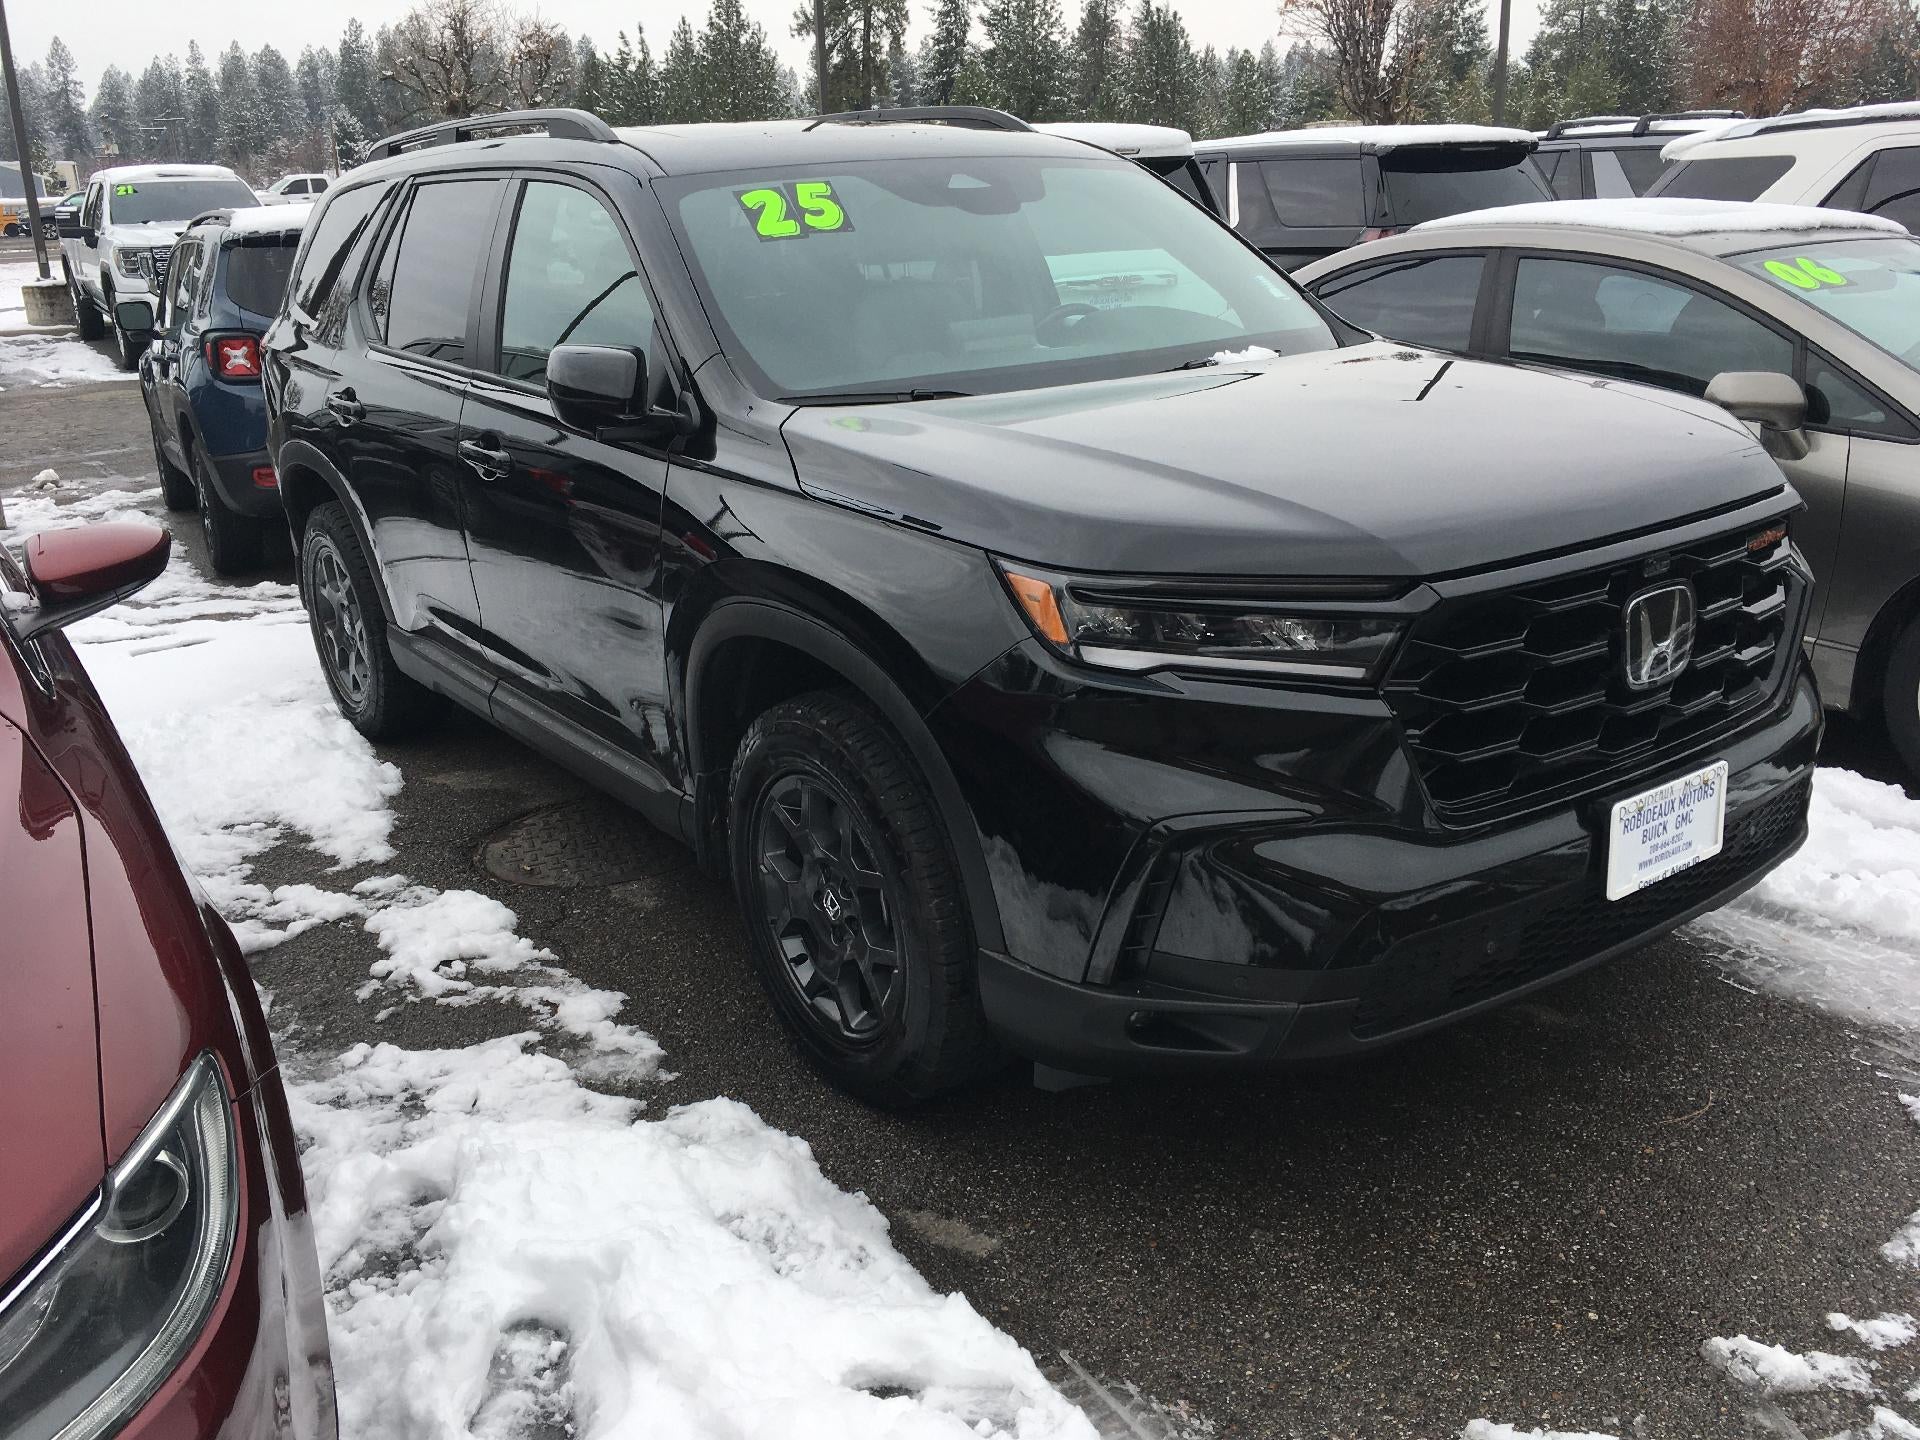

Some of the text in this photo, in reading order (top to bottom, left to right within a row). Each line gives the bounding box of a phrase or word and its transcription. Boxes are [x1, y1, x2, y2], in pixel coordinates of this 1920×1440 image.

[116, 185, 135, 196] 21
[740, 182, 844, 237] 25
[1763, 257, 1848, 289] 06
[1682, 766, 1726, 795] MOORS
[1623, 781, 1715, 835] ROBIDEAUX MOTORS
[1642, 809, 1694, 844] BUICK GMC
